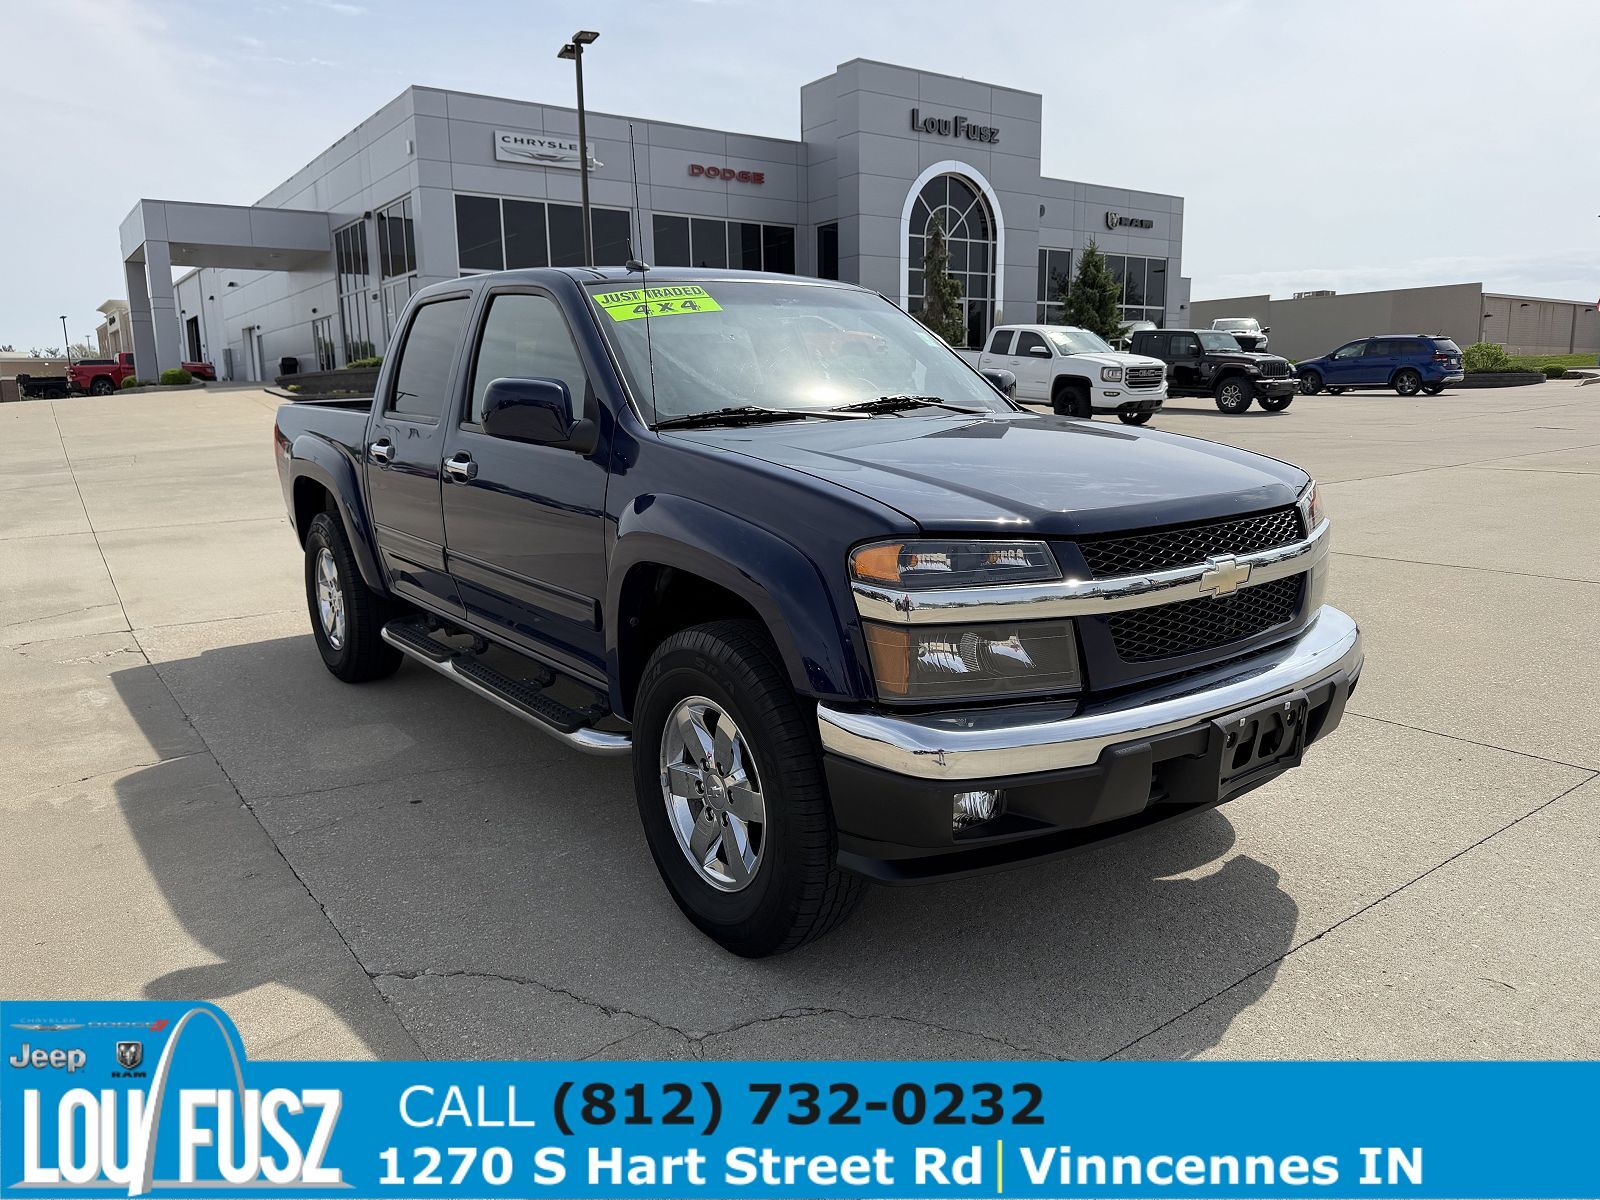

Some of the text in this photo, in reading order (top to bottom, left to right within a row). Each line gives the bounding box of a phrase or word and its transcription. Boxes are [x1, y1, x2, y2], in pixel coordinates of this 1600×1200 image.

[911, 108, 1000, 144] Lou Fusz
[501, 136, 588, 152] CHRYSLE
[688, 164, 765, 185] DODGE
[602, 286, 704, 304] JUST TRADED
